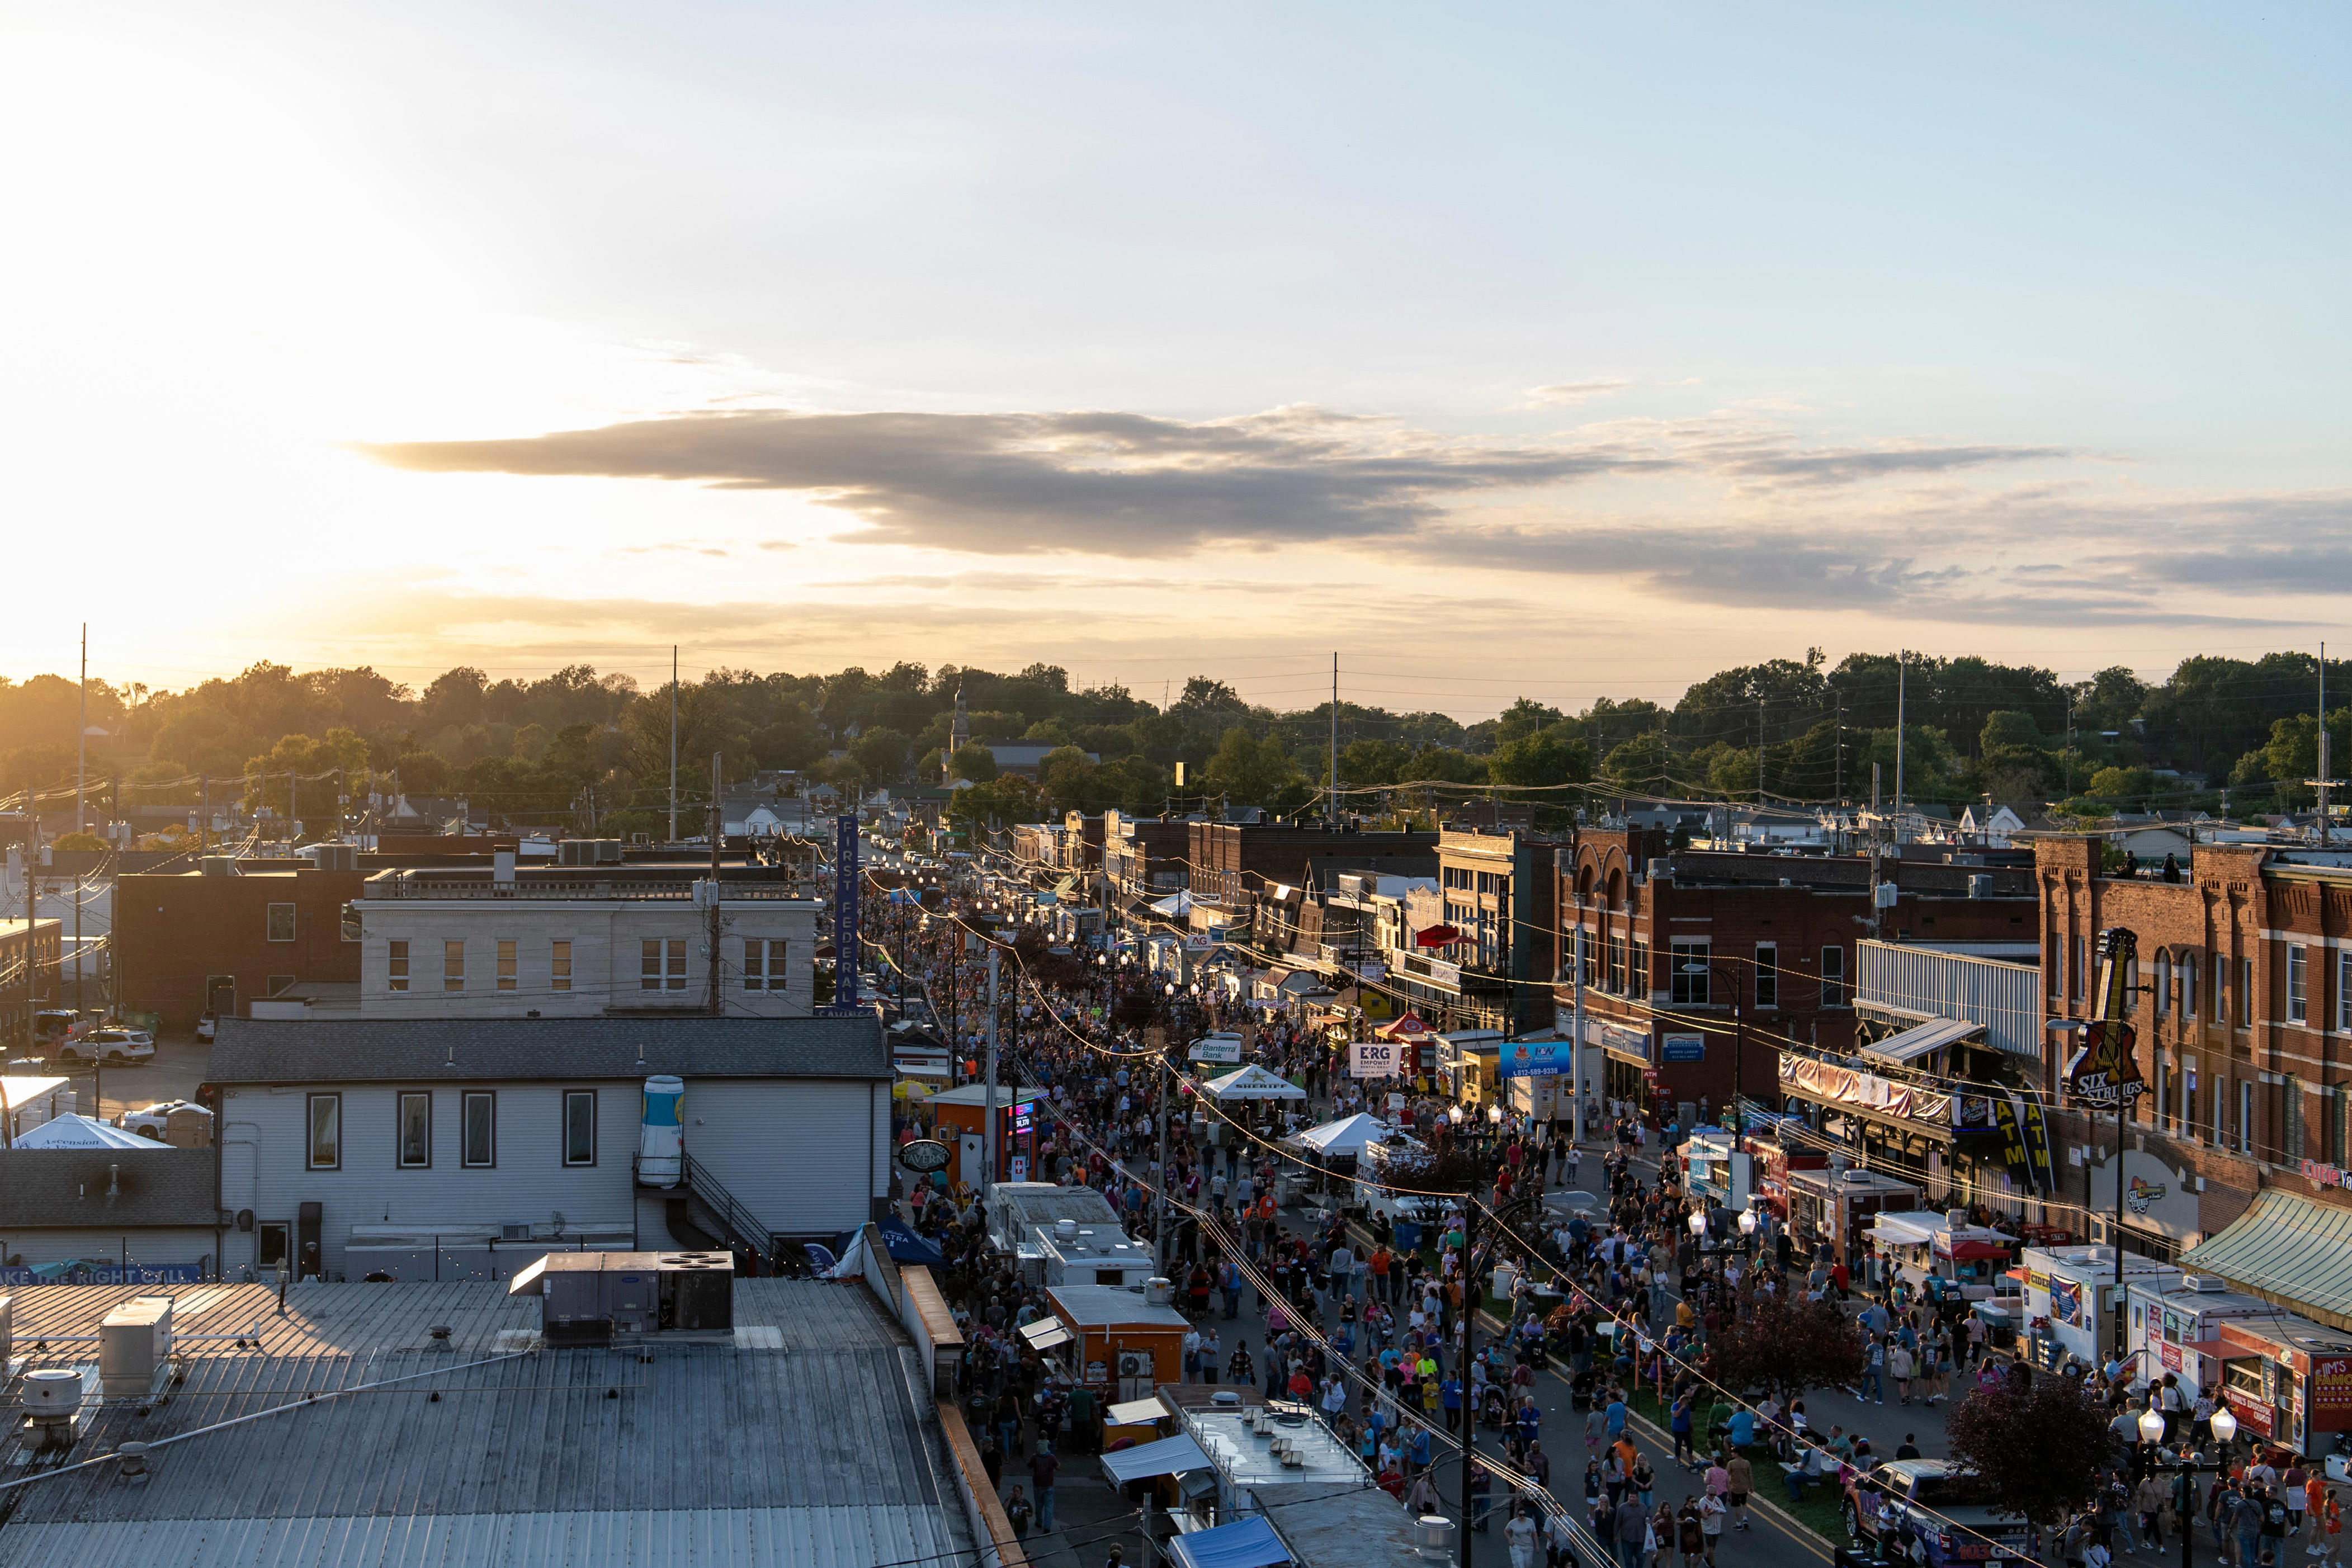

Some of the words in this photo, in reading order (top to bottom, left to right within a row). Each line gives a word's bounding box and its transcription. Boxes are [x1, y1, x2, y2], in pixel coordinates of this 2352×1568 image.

[843, 821, 853, 892] FIRST
[1192, 937, 1207, 945] AG
[842, 902, 853, 1003] FEDERAL
[1202, 1044, 1236, 1052] Banterra
[1360, 1047, 1390, 1059] ERG
[1517, 1068, 1558, 1076] 812-589-9338
[2078, 1071, 2108, 1094] SIX
[1996, 1101, 2025, 1165] ATM
[2027, 1102, 2049, 1168] ATM
[904, 1143, 929, 1154] FRANKLIN
[929, 1143, 948, 1154] STREET
[901, 1154, 946, 1164] TAVERN
[2301, 1159, 2339, 1187] Cutie
[2128, 1189, 2138, 1202] SIX
[2131, 1197, 2149, 1208] STRINGS
[77, 1269, 136, 1285] RIGHT
[2322, 1360, 2346, 1378] JIM'S
[2231, 1392, 2247, 1406] PAUL'S
